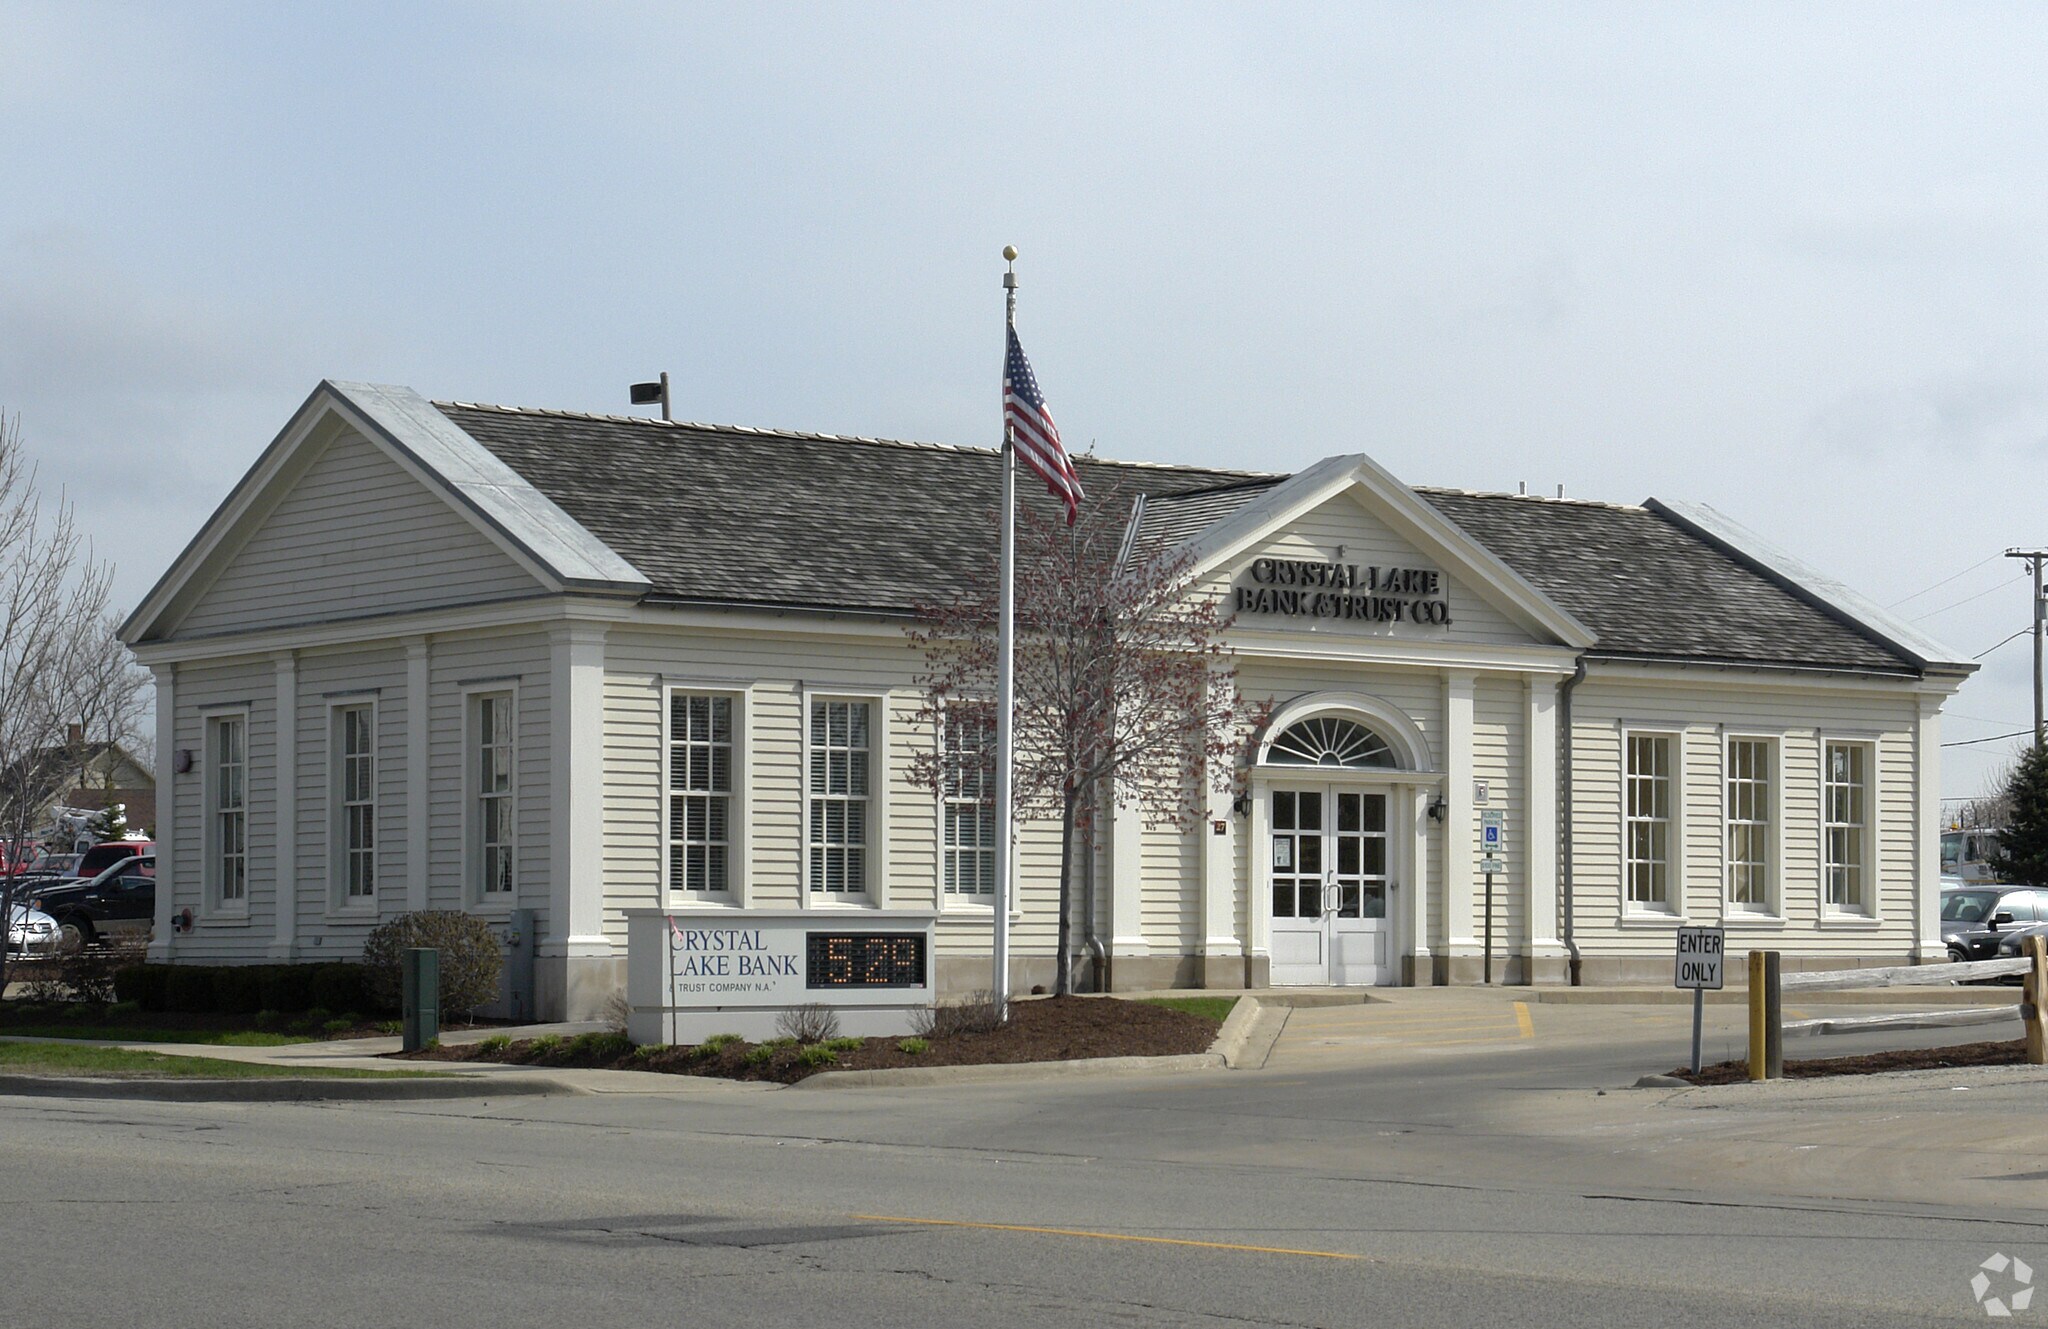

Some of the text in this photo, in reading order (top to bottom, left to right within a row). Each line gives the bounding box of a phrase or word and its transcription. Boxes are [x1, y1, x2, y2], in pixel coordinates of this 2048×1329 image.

[1251, 558, 1440, 595] CRYSTAL LAKE
[1236, 586, 1313, 615] BANK
[1333, 595, 1408, 622] TRUST
[671, 930, 768, 951] CRYSTAL
[1681, 935, 1721, 954] ENTER
[670, 955, 799, 976] LAKE BANK
[1683, 962, 1716, 981] ONLY
[679, 983, 706, 992] TRUST
[709, 983, 752, 992] COMPANY
